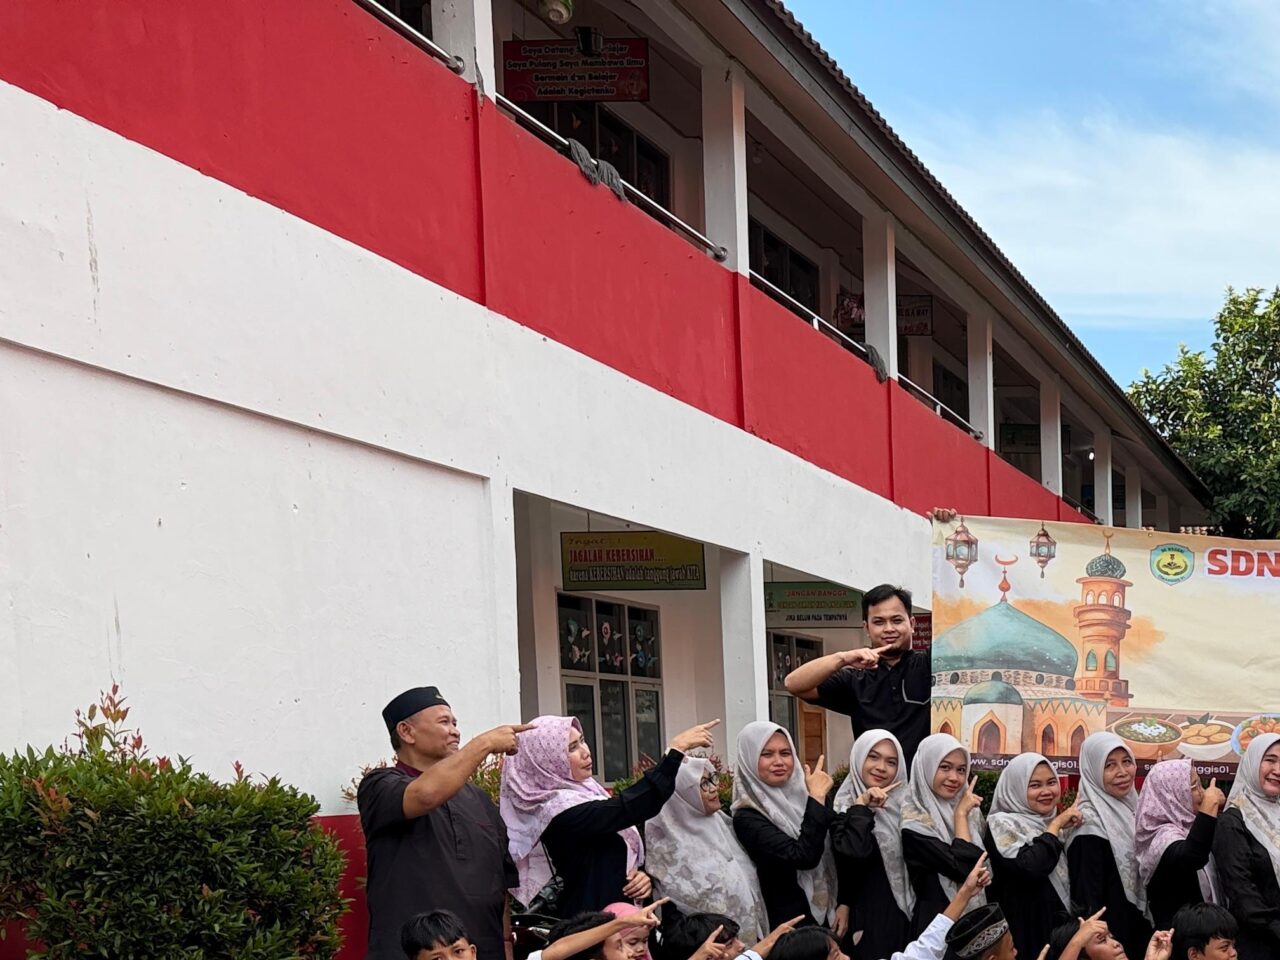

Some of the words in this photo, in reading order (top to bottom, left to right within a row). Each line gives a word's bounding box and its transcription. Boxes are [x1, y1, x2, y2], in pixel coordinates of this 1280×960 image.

[544, 45, 575, 55] Datang
[507, 61, 527, 70] Saya
[529, 60, 556, 69] Pulang
[588, 73, 618, 82] Belajar
[569, 549, 603, 562] JAGALAH
